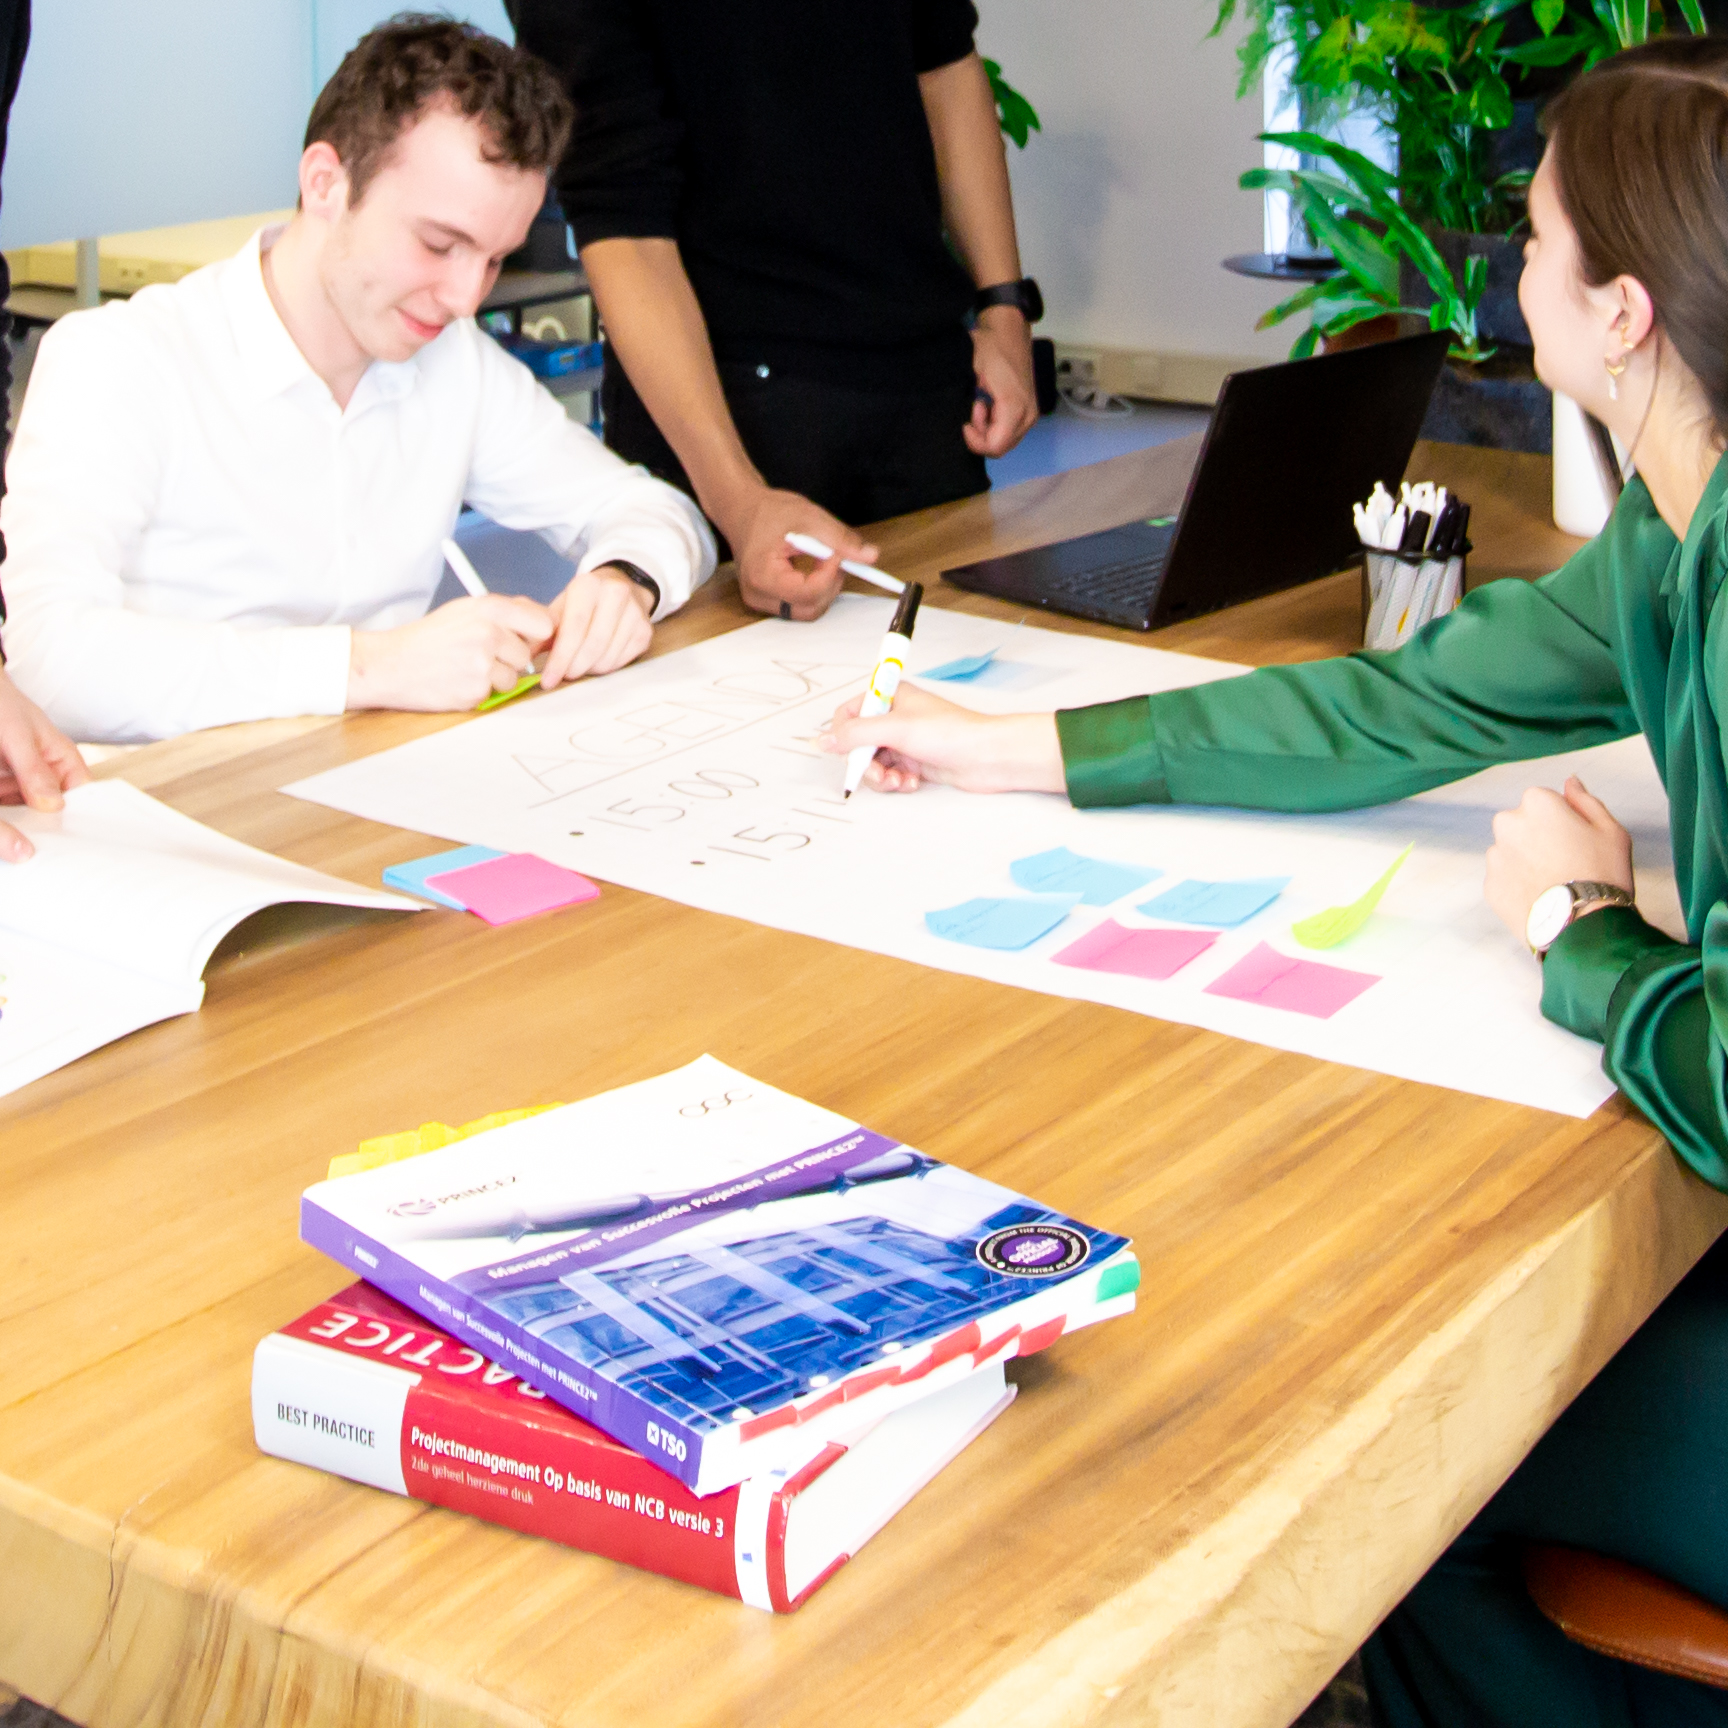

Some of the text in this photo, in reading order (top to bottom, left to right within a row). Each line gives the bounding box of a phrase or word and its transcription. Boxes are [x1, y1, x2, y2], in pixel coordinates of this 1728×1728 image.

[511, 659, 870, 793] AGENDA
[488, 1249, 568, 1279] Managen
[570, 1237, 602, 1254] van
[690, 1178, 764, 1210] Projecten
[764, 1165, 795, 1182] met
[277, 1403, 376, 1449] BEST PRACTICE
[659, 1429, 687, 1462] TSO
[411, 1426, 725, 1538] Projectmanagement Op basis van NCB versie 3
[511, 1486, 534, 1505] druk
